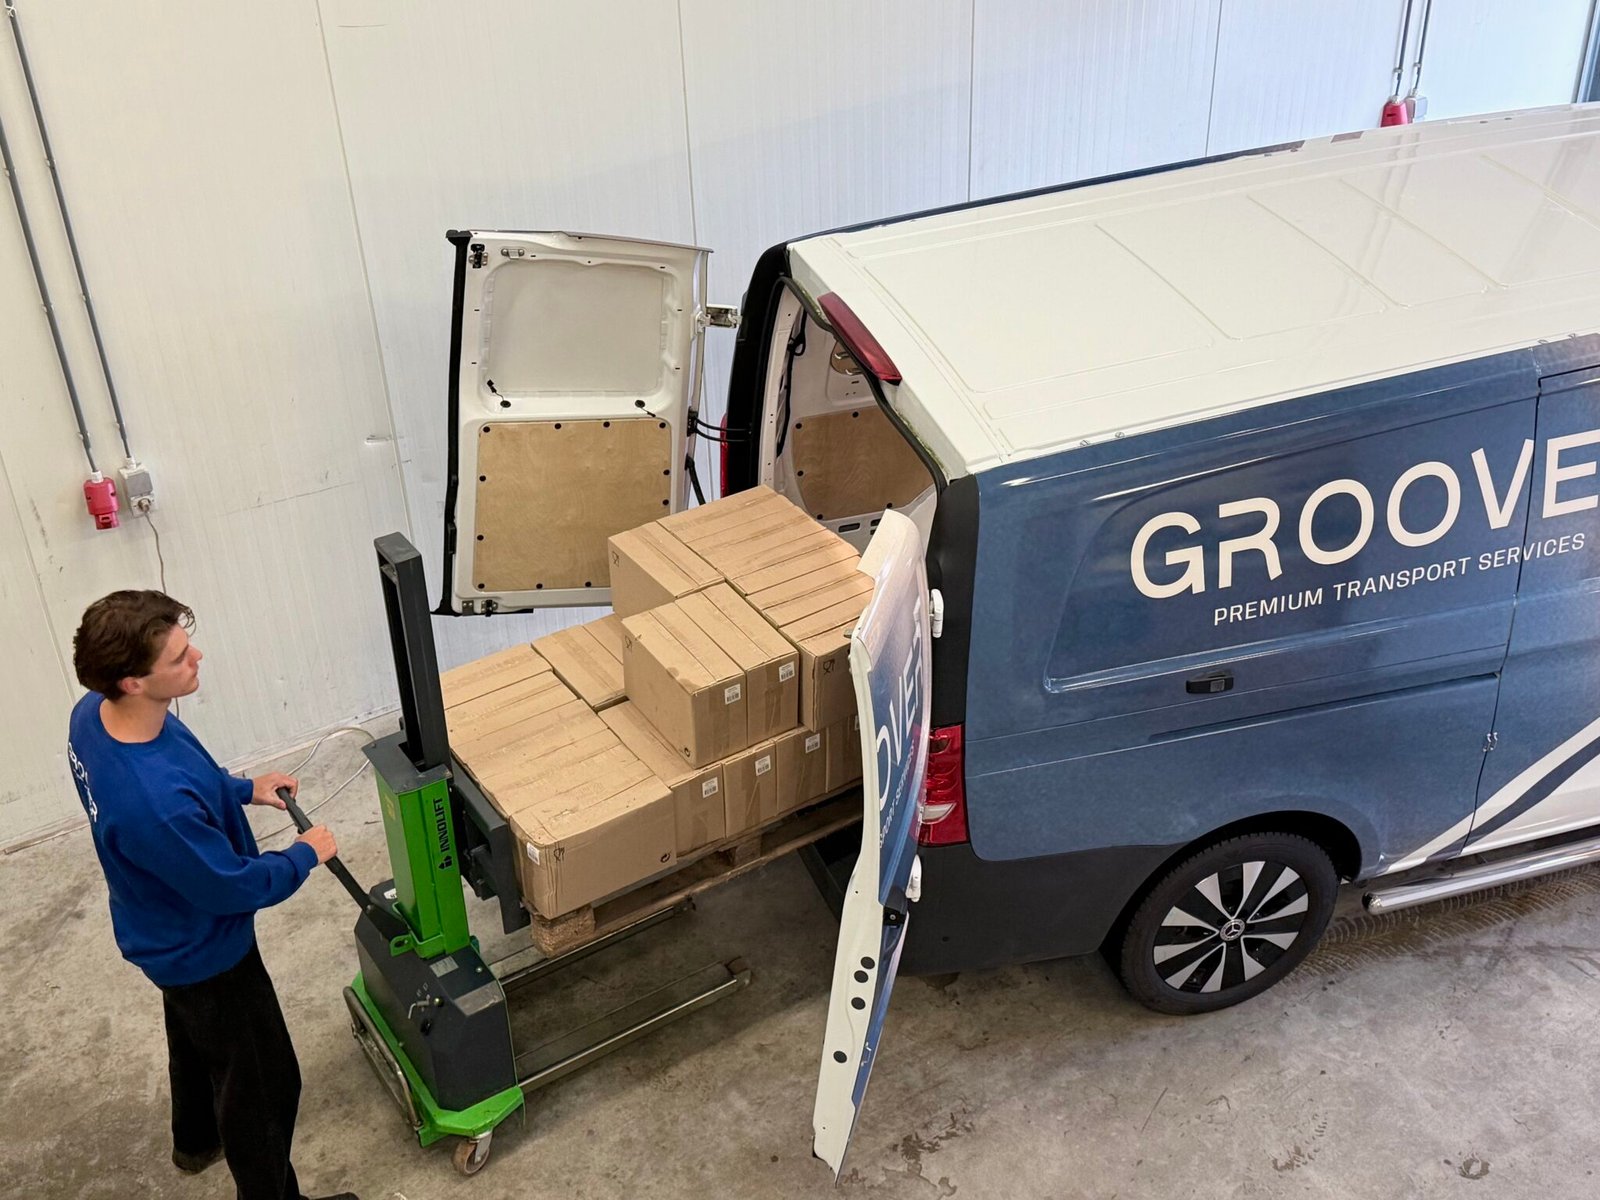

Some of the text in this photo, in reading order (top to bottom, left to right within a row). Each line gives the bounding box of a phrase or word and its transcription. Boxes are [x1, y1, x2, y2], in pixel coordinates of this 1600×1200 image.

[1130, 429, 1600, 599] GROOVE
[1214, 532, 1586, 626] PREMIUM TRANSPORT SERVICES
[433, 798, 450, 852] INNOLIFT
